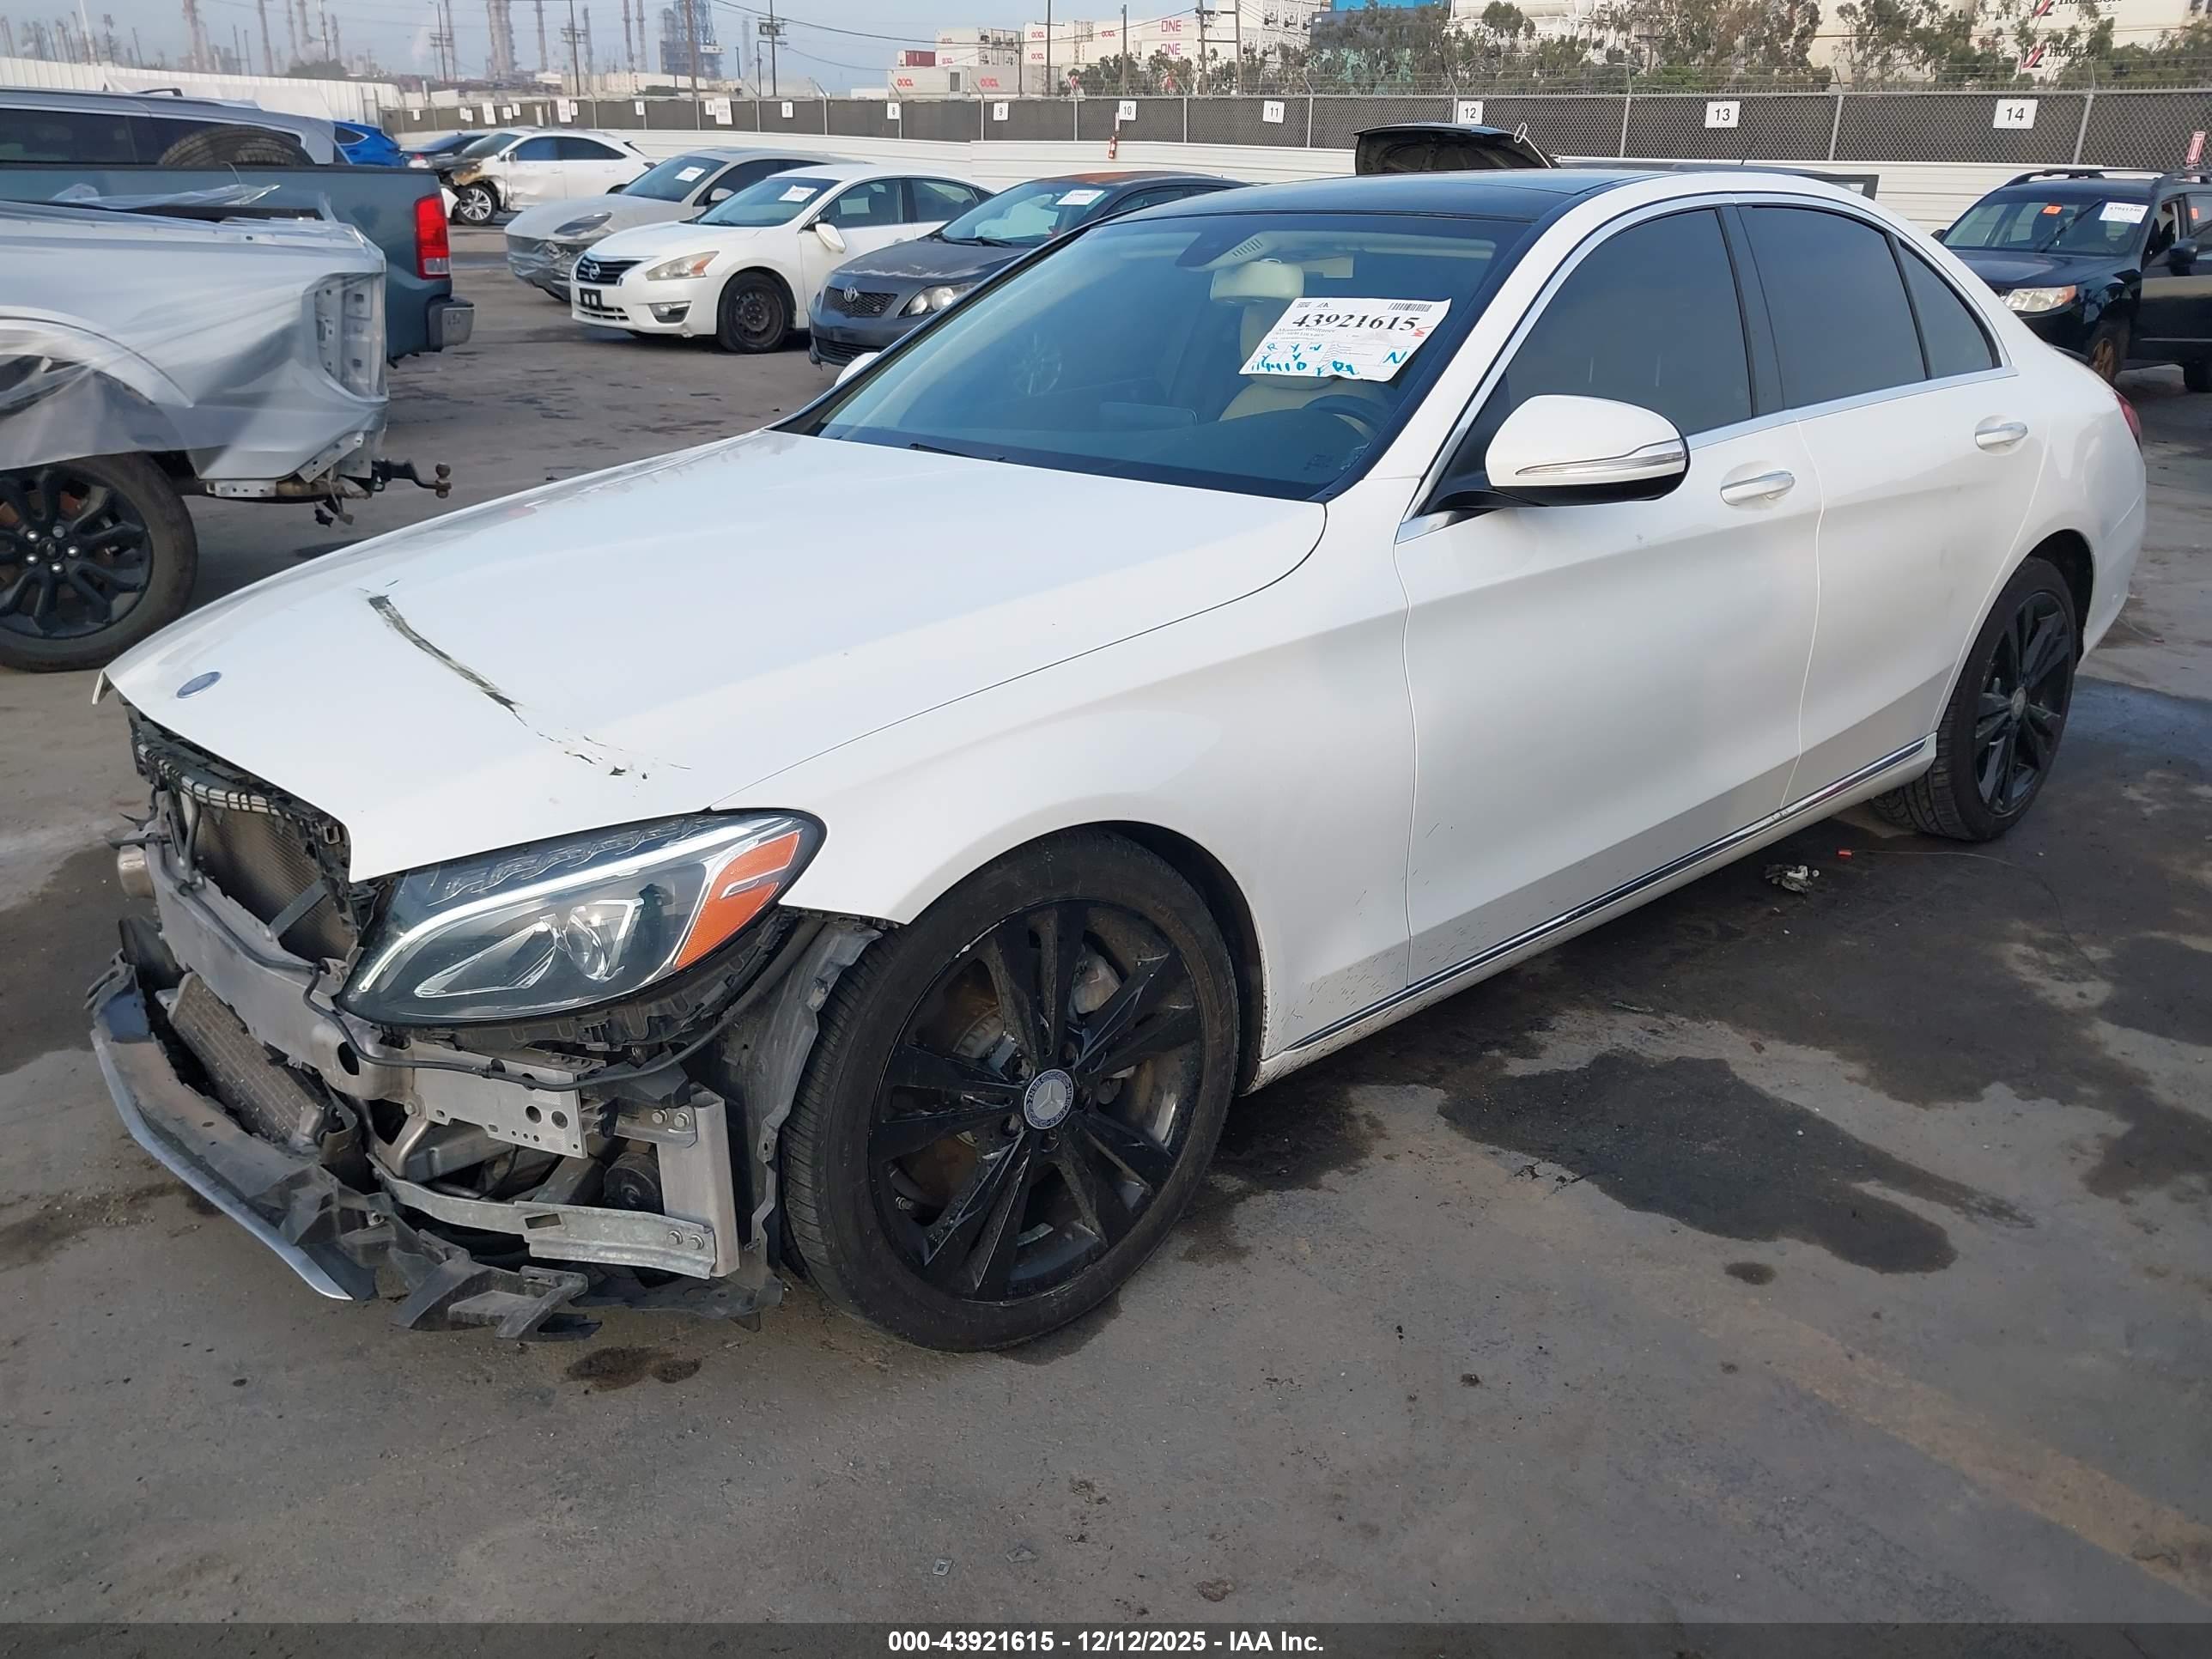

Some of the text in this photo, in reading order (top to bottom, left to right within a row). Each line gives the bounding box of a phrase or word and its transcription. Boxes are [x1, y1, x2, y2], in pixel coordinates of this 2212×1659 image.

[1161, 20, 1182, 33] ONE
[1161, 43, 1181, 56] ONE
[1122, 106, 1133, 116] 10
[1270, 106, 1279, 118] 11
[1464, 107, 1477, 119] 12
[1715, 108, 1730, 122] 13
[2006, 106, 2025, 122] 14
[1292, 313, 1421, 331] 43921615
